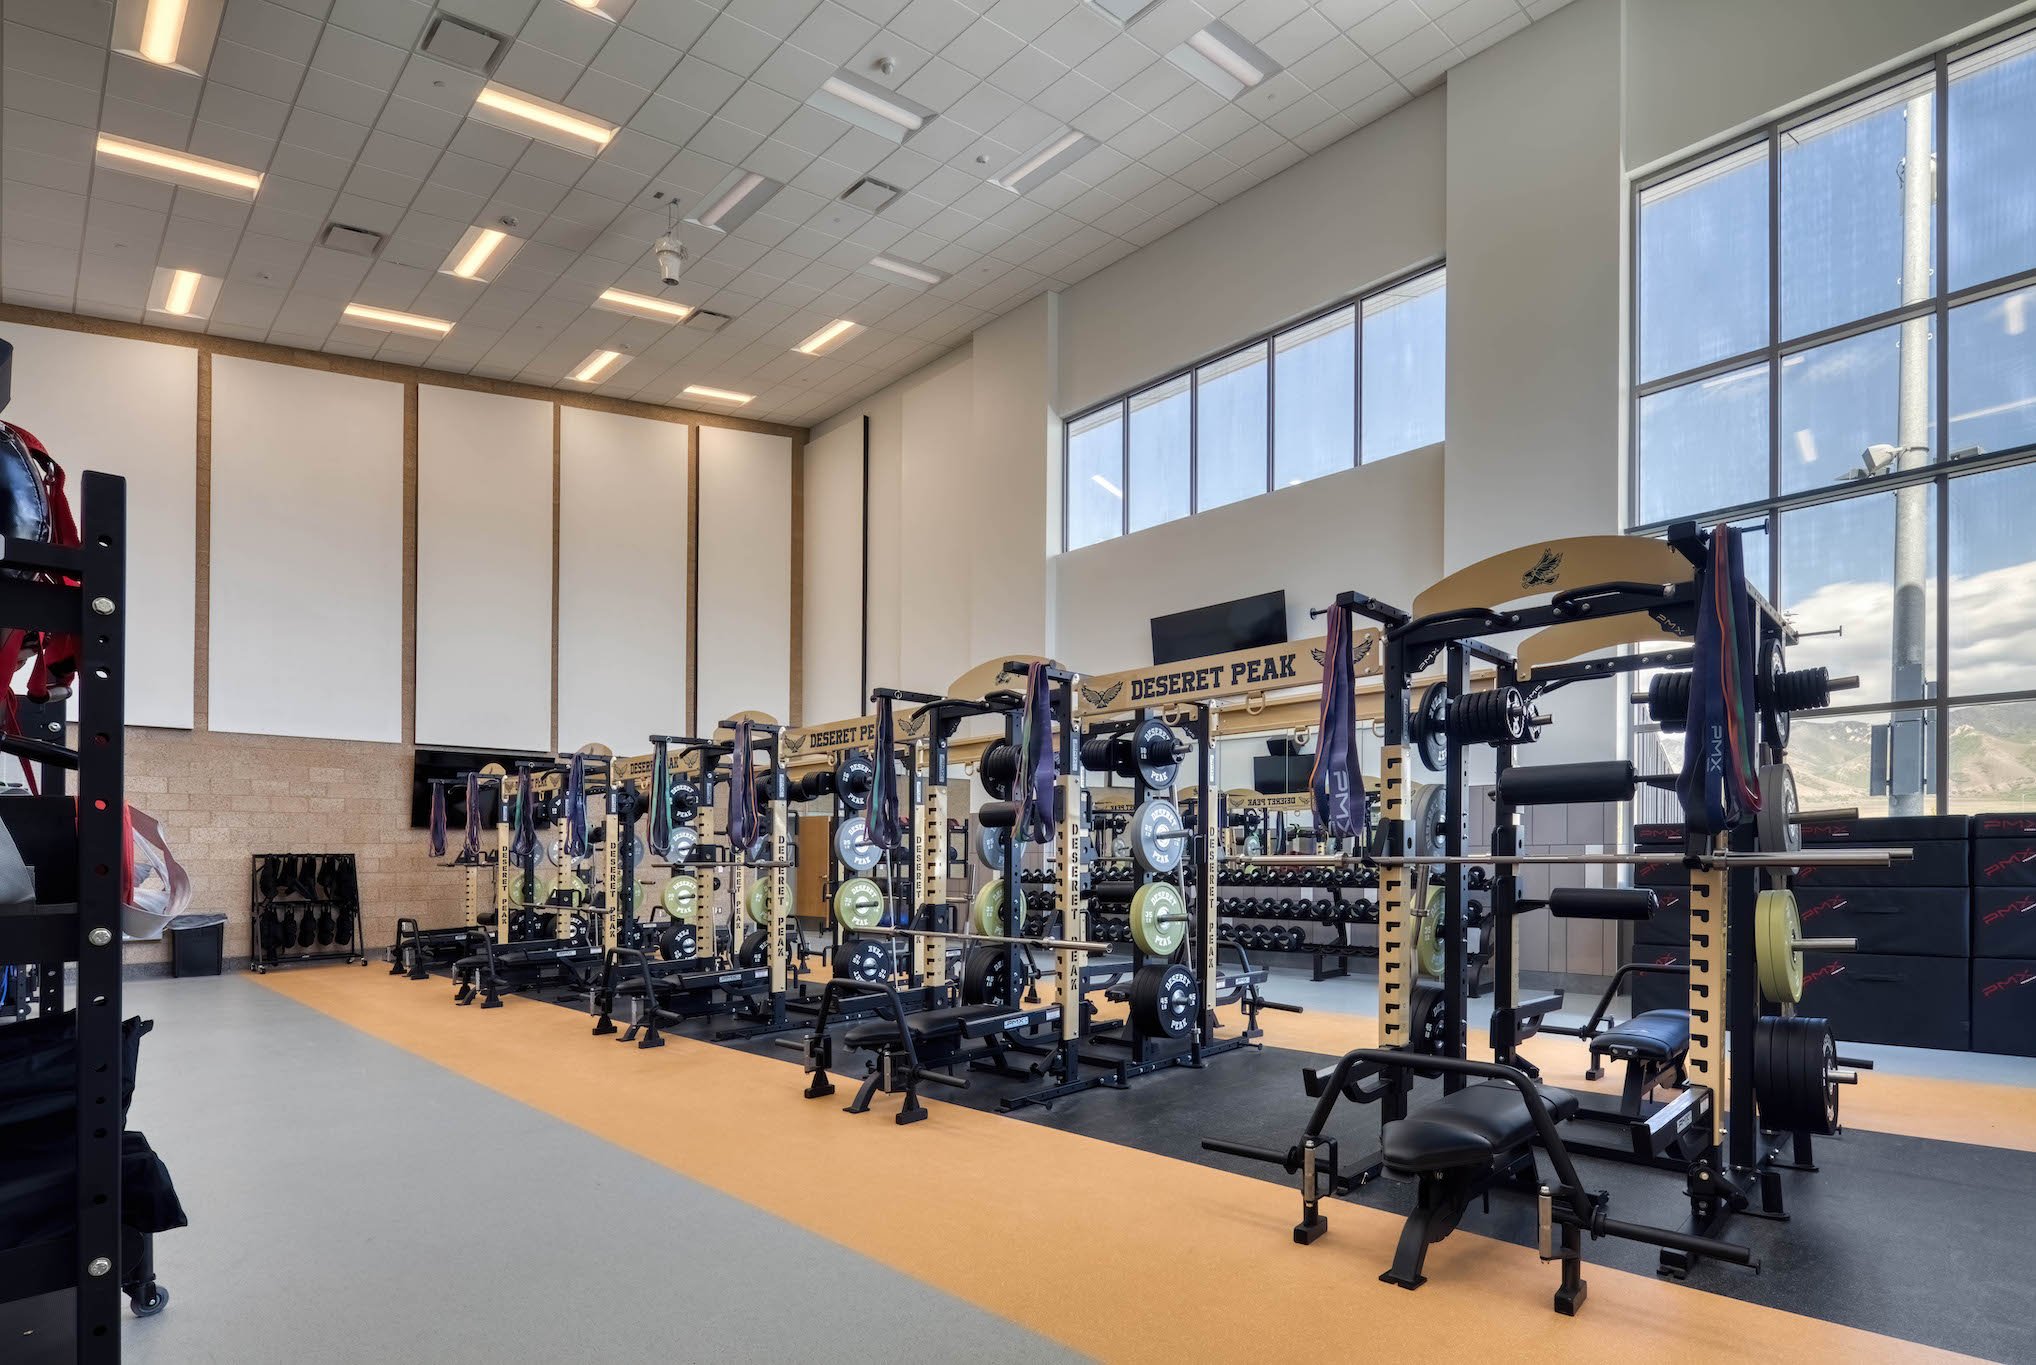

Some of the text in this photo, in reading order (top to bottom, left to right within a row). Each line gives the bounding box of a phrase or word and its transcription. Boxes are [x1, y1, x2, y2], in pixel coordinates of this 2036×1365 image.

[1656, 614, 1685, 636] PMX
[1418, 648, 1440, 670] PMX
[1131, 653, 1296, 700] DESERET PEAK
[810, 724, 875, 748] DESERET PE
[1144, 727, 1170, 741] DESERET
[1711, 725, 1722, 772] PMX
[1151, 770, 1168, 782] PEAK
[848, 792, 865, 805] PEAK
[1151, 809, 1177, 826] DESERET
[1640, 829, 1682, 838] PMX
[1801, 825, 1849, 834] PMX
[854, 856, 871, 865] PEAK
[1152, 850, 1170, 864] PEAK
[1984, 847, 2033, 880] PMX
[609, 842, 617, 898] DESERET
[1071, 823, 1079, 920] DESERET
[673, 880, 696, 890] DESERET
[851, 885, 877, 898] DESERET
[1151, 890, 1177, 906] DESERET
[676, 906, 692, 914] PEAK
[1801, 895, 1842, 921] PMX
[1983, 896, 2032, 925] PMX
[851, 917, 869, 926] PEAK
[1154, 935, 1172, 947] PEAK
[868, 945, 884, 959] PEAK
[1165, 973, 1191, 992] DESERET
[1983, 970, 2031, 997] PMX
[1160, 997, 1168, 1005] 45
[1170, 1017, 1188, 1031] PEAK
